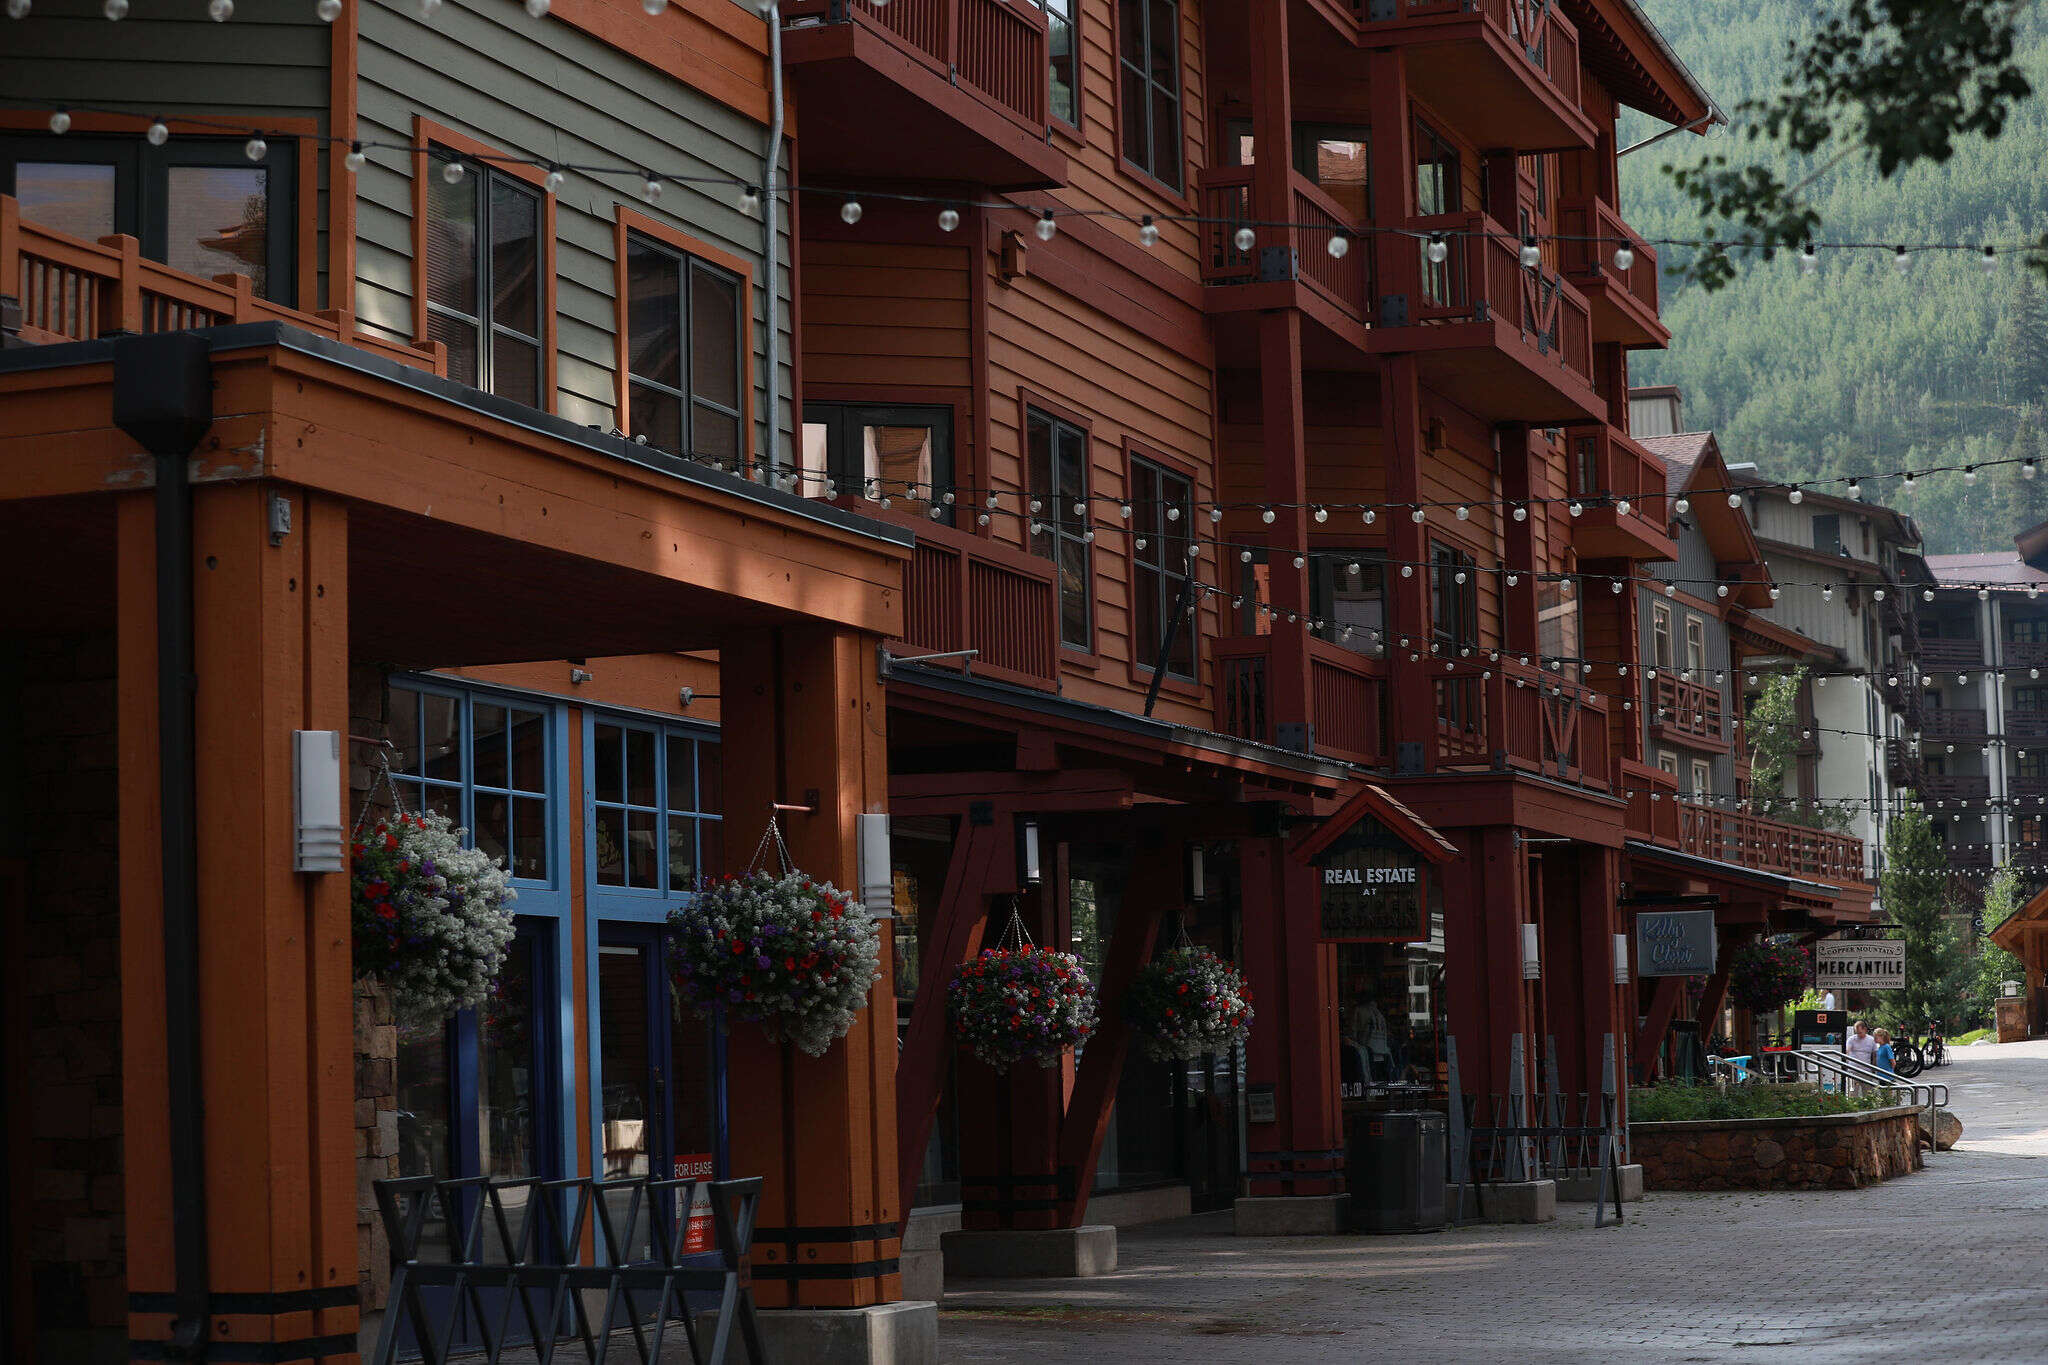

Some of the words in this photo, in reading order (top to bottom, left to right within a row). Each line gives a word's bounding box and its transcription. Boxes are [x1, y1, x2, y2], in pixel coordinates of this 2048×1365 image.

[1325, 868, 1362, 884] REAL
[1366, 867, 1416, 883] ESTATE
[1363, 888, 1377, 896] AT
[1826, 947, 1854, 956] COPPER
[1856, 946, 1894, 955] MOUNTAIN
[1818, 961, 1903, 975] MERCANTILE
[674, 1163, 689, 1178] FOR
[691, 1161, 713, 1176] LEASE
